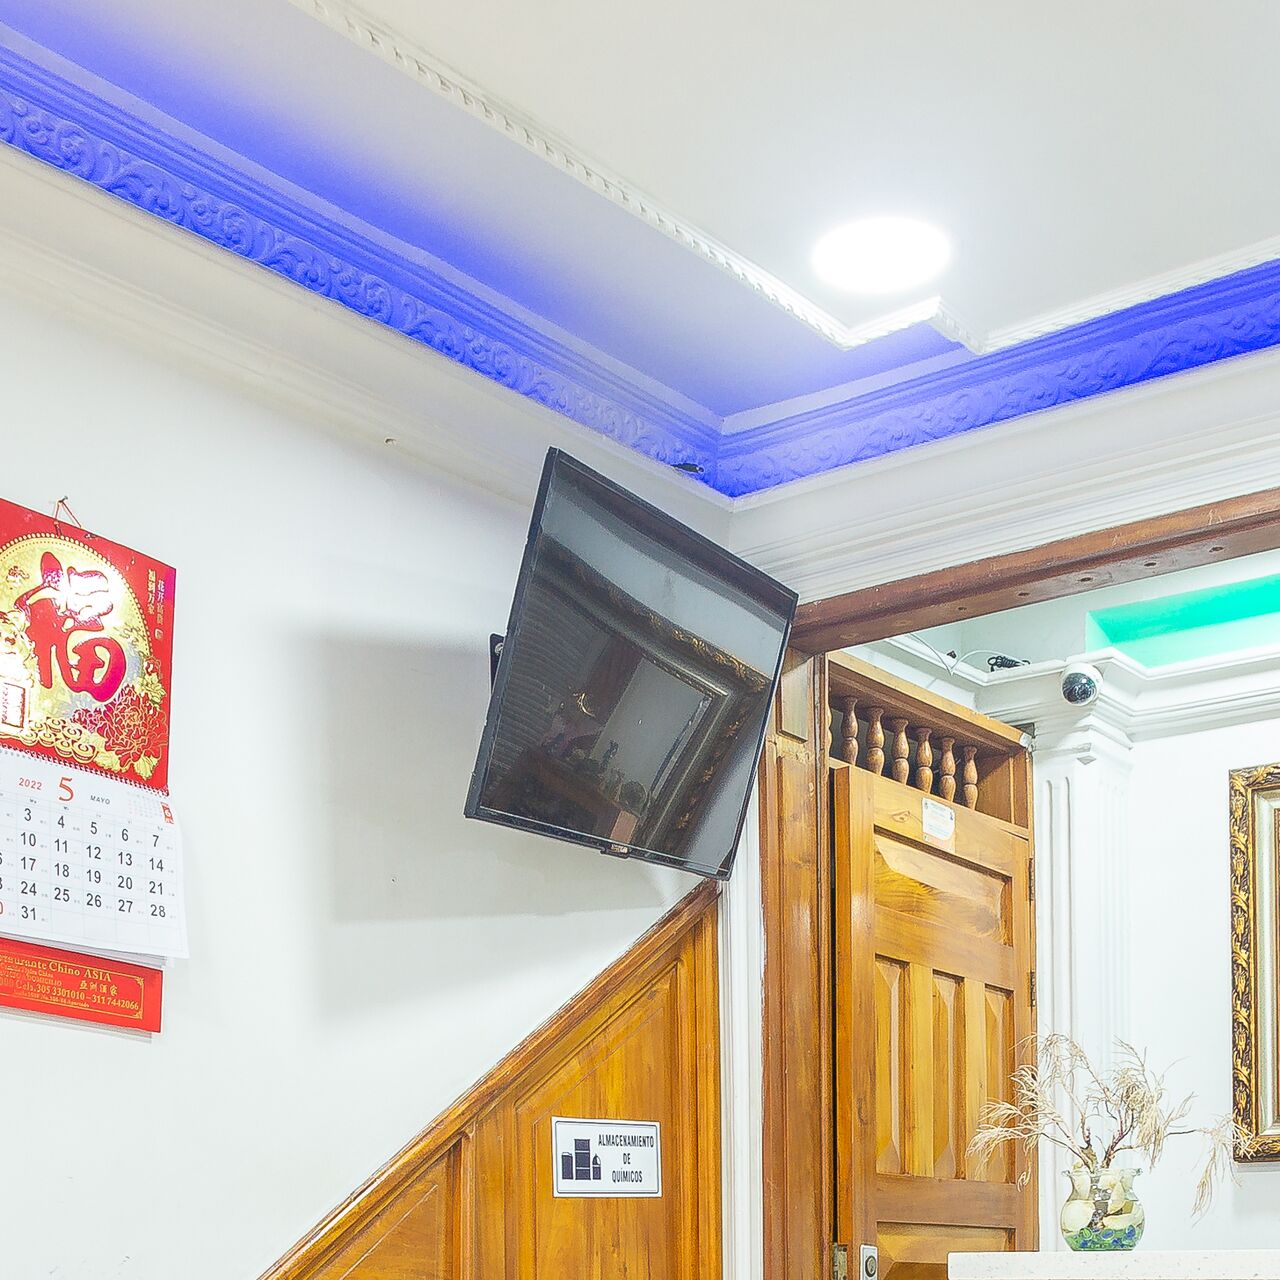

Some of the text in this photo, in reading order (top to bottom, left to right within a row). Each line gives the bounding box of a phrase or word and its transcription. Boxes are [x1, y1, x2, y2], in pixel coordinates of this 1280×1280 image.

[18, 777, 110, 805] 2022 5 MAYO
[23, 808, 32, 822] 3
[57, 816, 65, 829] 4
[90, 822, 98, 835] 5
[121, 829, 129, 842] 6
[152, 835, 160, 848] 7
[20, 832, 37, 847] 10
[54, 839, 68, 854] 11
[85, 845, 102, 860] 12
[118, 852, 133, 867] 13
[149, 858, 164, 872] 14
[20, 857, 37, 872] 17
[54, 863, 70, 878] 18
[86, 870, 102, 884] 19
[117, 876, 133, 890] 20
[148, 881, 163, 896] 21
[20, 881, 38, 897] 24
[53, 887, 70, 903] 25
[86, 893, 102, 908] 26
[118, 899, 134, 913] 27
[150, 904, 166, 918] 28
[21, 906, 36, 921] 31
[48, 960, 80, 976] Chino
[83, 969, 112, 982] ASIA
[52, 986, 85, 1000] 3301010
[598, 1134, 655, 1148] ALMACENAMIENTO
[622, 1152, 631, 1165] DE
[612, 1168, 643, 1183] QUÍMICOS
